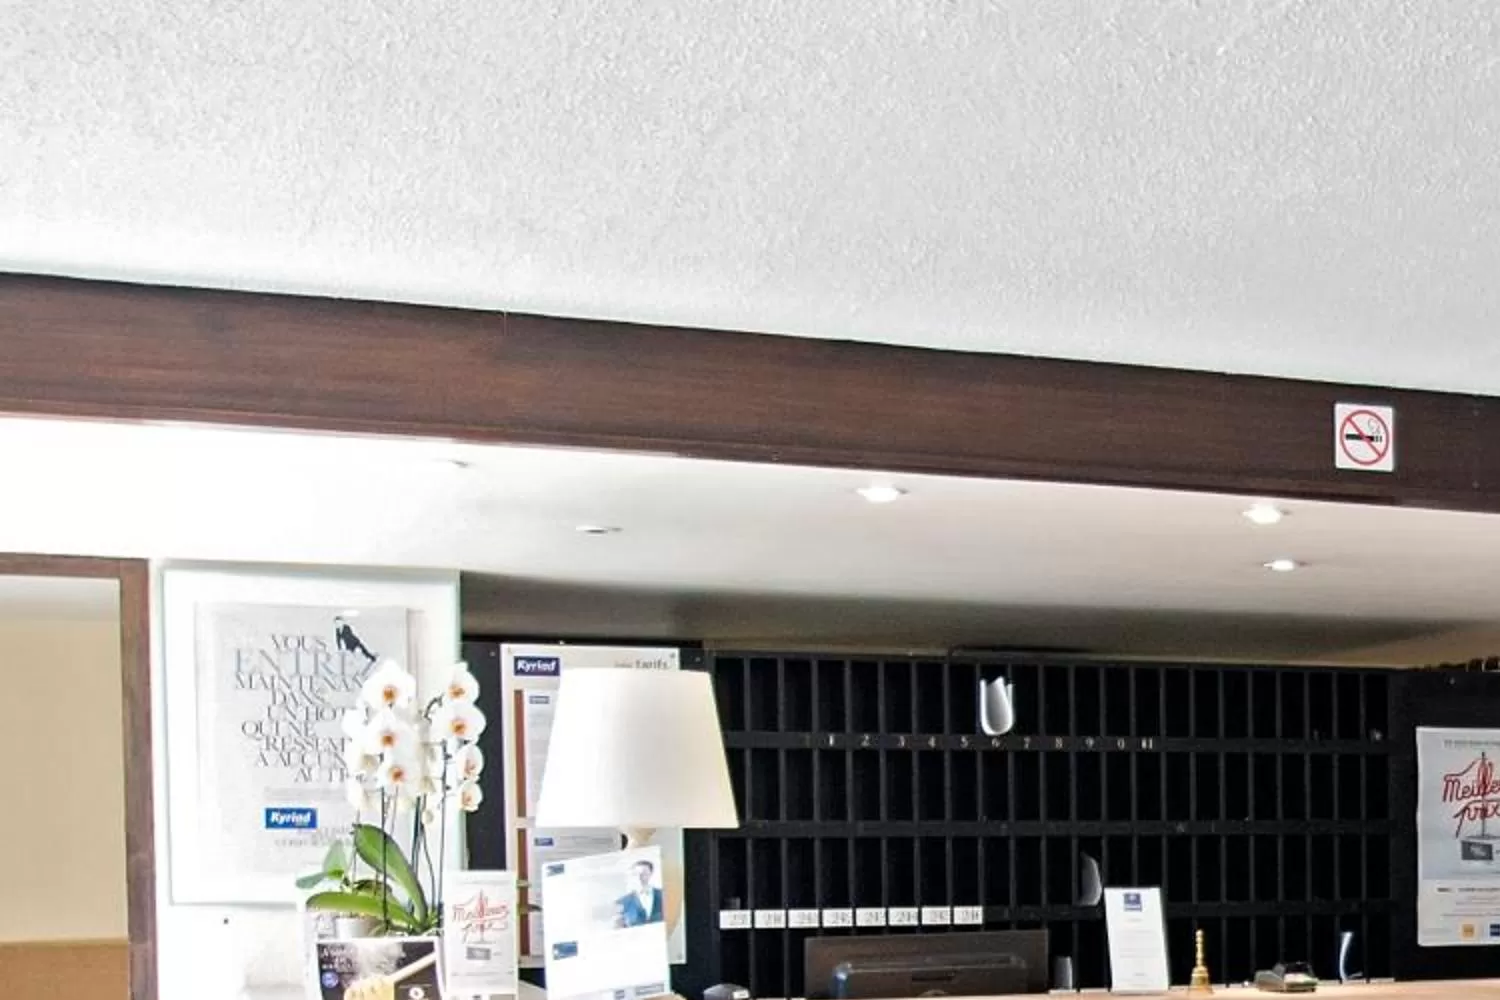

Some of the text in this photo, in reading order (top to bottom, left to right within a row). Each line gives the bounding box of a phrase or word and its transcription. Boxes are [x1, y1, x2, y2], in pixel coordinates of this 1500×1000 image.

[270, 634, 327, 651] VOUS
[516, 659, 557, 673] Kyriad
[235, 675, 367, 692] MAINTENAN
[241, 720, 315, 741] QUI NE
